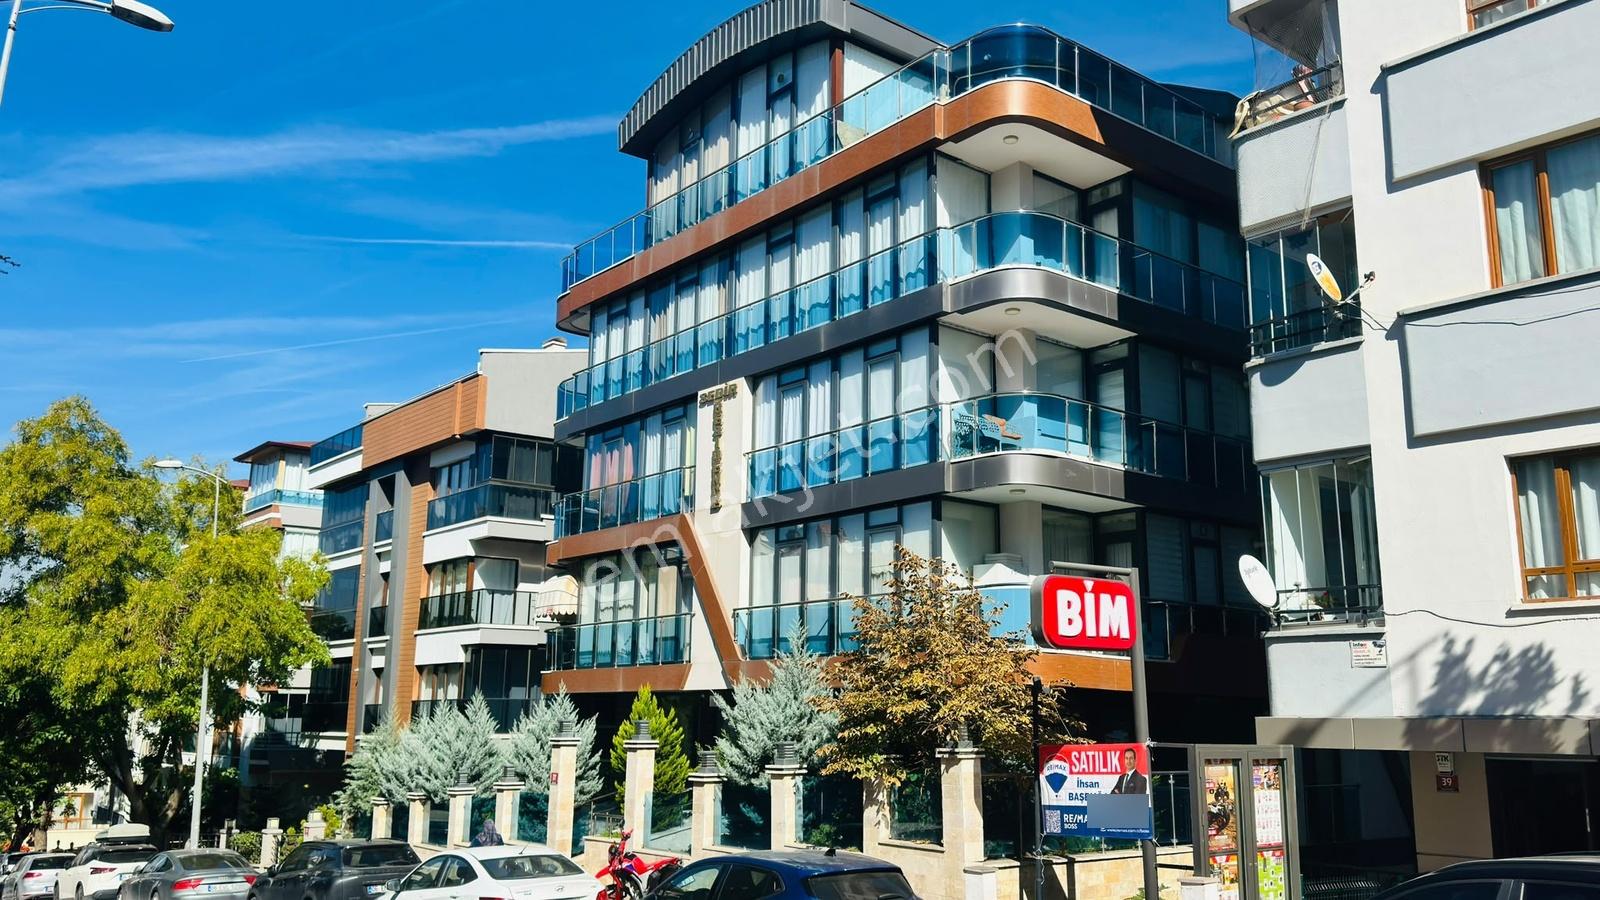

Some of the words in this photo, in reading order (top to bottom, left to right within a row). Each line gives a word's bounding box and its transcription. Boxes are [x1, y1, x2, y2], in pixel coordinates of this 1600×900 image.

[1056, 580, 1130, 639] BİM
[1071, 751, 1121, 773] SATILIK
[1047, 764, 1066, 772] RE/MAX
[1077, 777, 1100, 788] İhsan
[1442, 777, 1452, 787] 39
[1063, 813, 1087, 824] RE/MA
